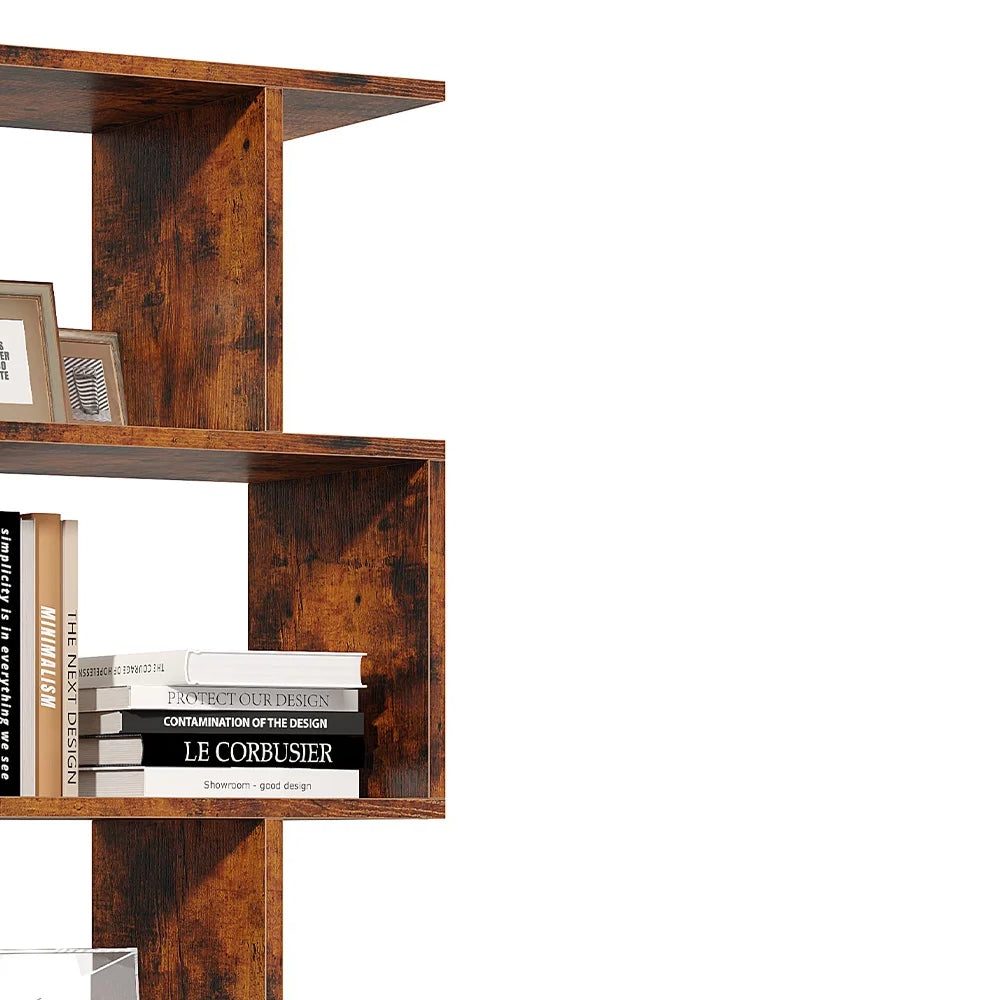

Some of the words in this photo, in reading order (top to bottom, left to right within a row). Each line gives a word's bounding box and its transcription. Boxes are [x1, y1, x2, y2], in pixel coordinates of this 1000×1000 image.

[1, 606, 10, 621] is
[1, 625, 10, 640] in
[67, 611, 77, 646] THE
[41, 605, 56, 709] MINIMALISM
[153, 663, 164, 673] THE
[67, 654, 77, 704] NEXT
[168, 691, 236, 706] PROTECT
[239, 692, 272, 706] OUR
[276, 693, 329, 707] DESIGN
[163, 716, 250, 728] CONTAMINATION
[252, 717, 267, 728] OF
[267, 717, 288, 728] THE
[289, 718, 328, 729] DESIGN
[1, 729, 9, 750] we
[67, 713, 77, 785] DESIGN
[184, 741, 209, 762] LE
[216, 741, 333, 763] CORBUSIER
[1, 754, 9, 780] see
[203, 780, 250, 790] Showroom
[260, 781, 280, 792] good
[284, 781, 312, 792] design
